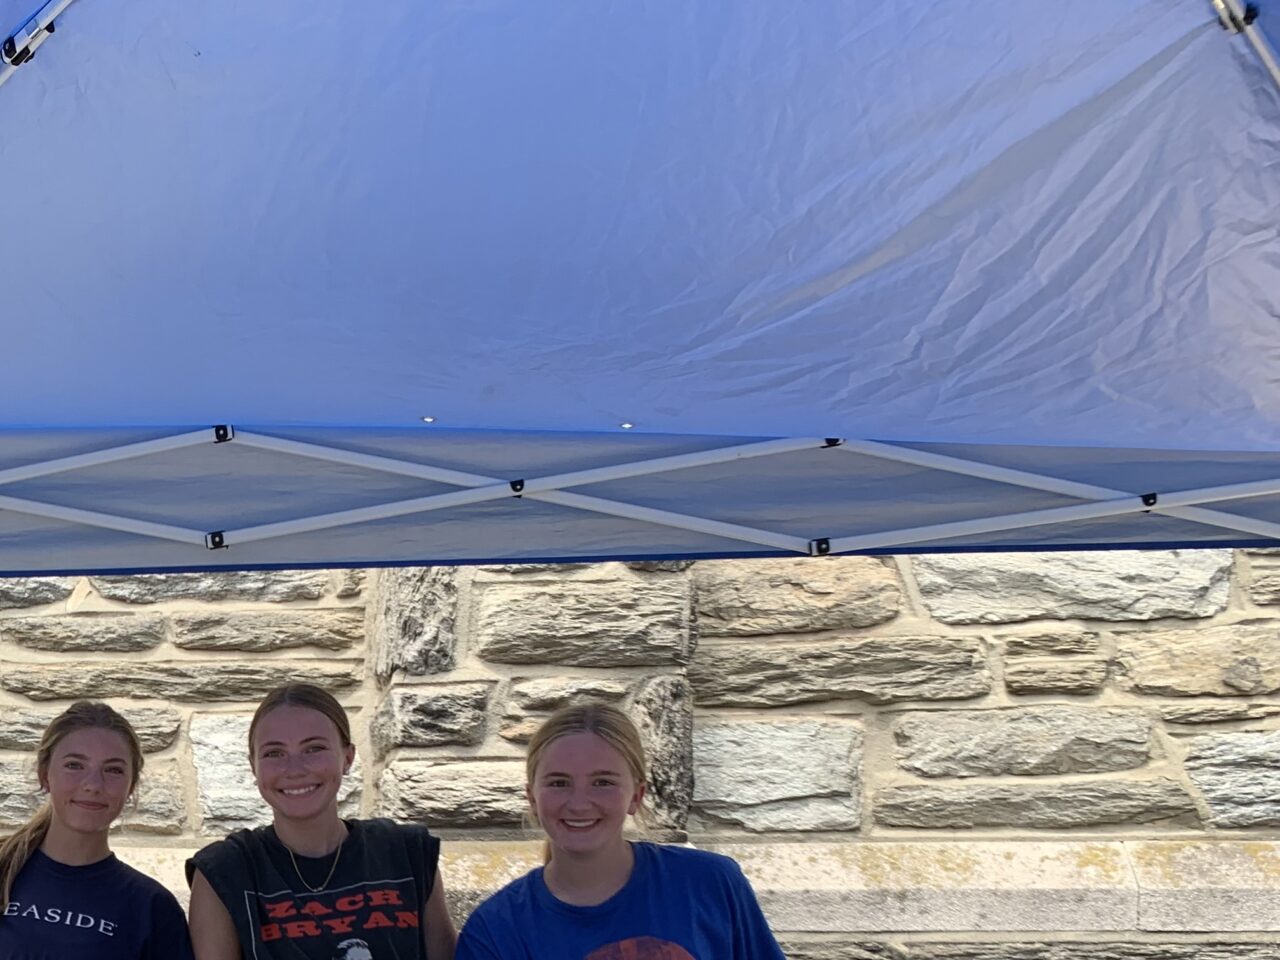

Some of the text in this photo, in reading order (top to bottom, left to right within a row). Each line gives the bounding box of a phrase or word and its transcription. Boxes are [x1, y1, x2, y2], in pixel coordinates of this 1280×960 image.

[3, 902, 116, 937] EASIDE
[265, 889, 403, 918] ZACH
[261, 910, 419, 942] BRYAN
